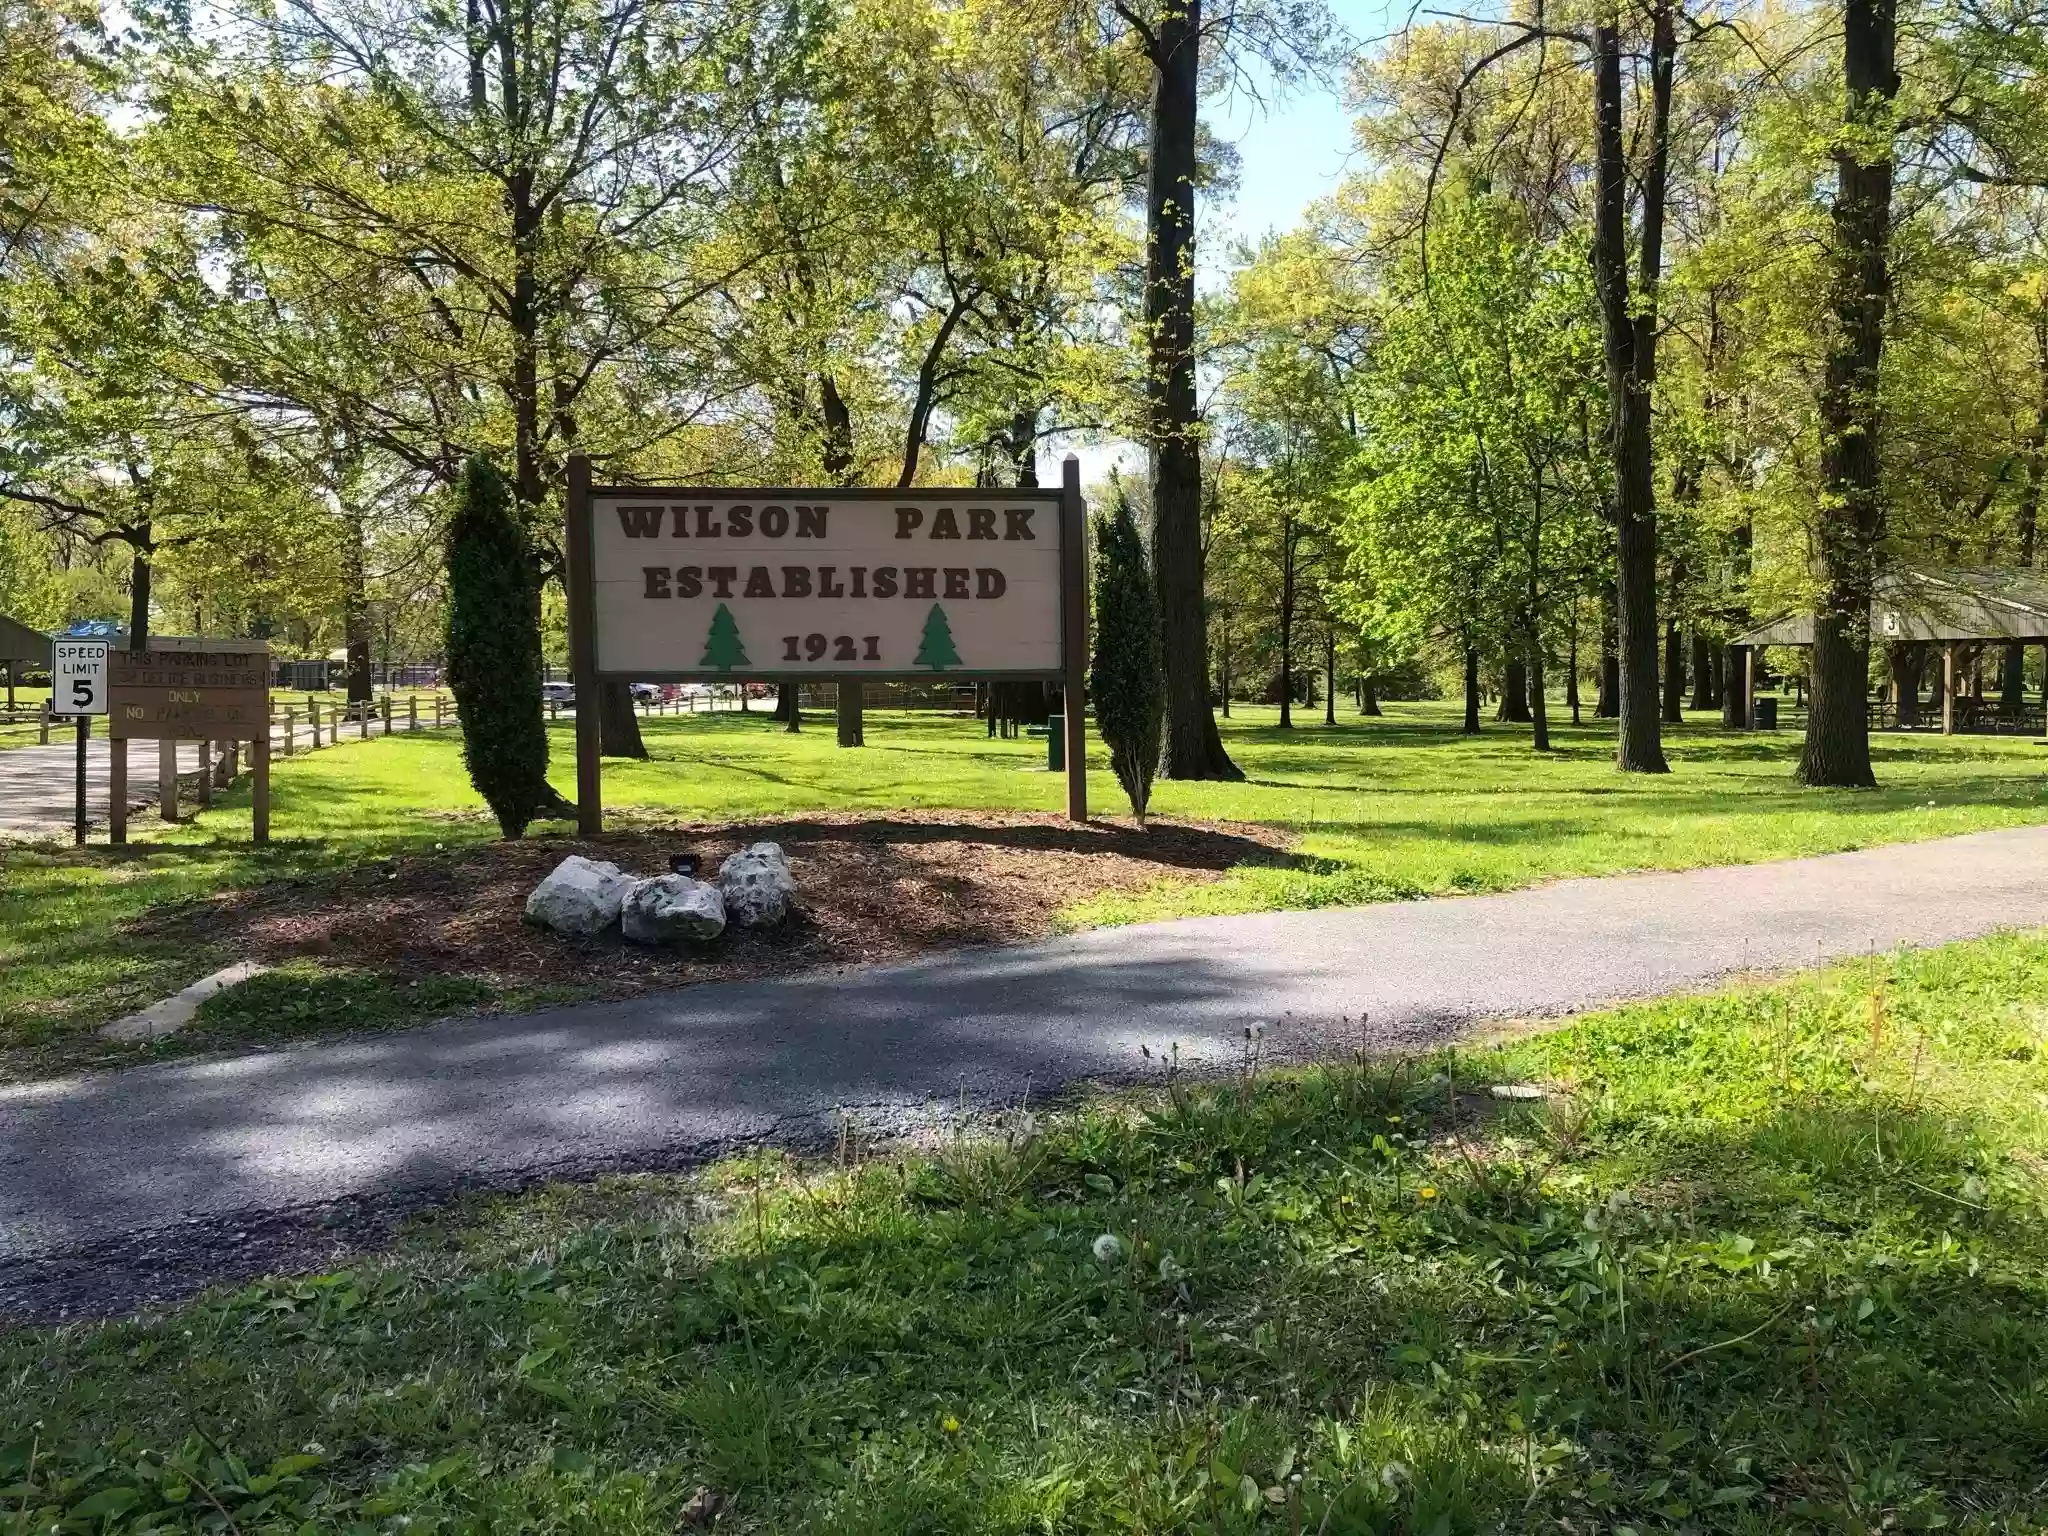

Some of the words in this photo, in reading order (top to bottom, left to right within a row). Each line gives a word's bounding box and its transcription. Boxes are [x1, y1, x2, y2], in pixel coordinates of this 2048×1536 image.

[617, 505, 830, 539] WILSON
[894, 508, 1036, 541] PARK
[643, 566, 1007, 600] ESTABLISHED
[58, 647, 105, 658] SPEED
[782, 633, 881, 661] 1921
[119, 652, 152, 668] THIS
[223, 653, 251, 667] LOT
[63, 663, 99, 674] LIMIT
[72, 680, 94, 707] 5
[168, 691, 200, 703] ONLY
[126, 707, 144, 719] NO
